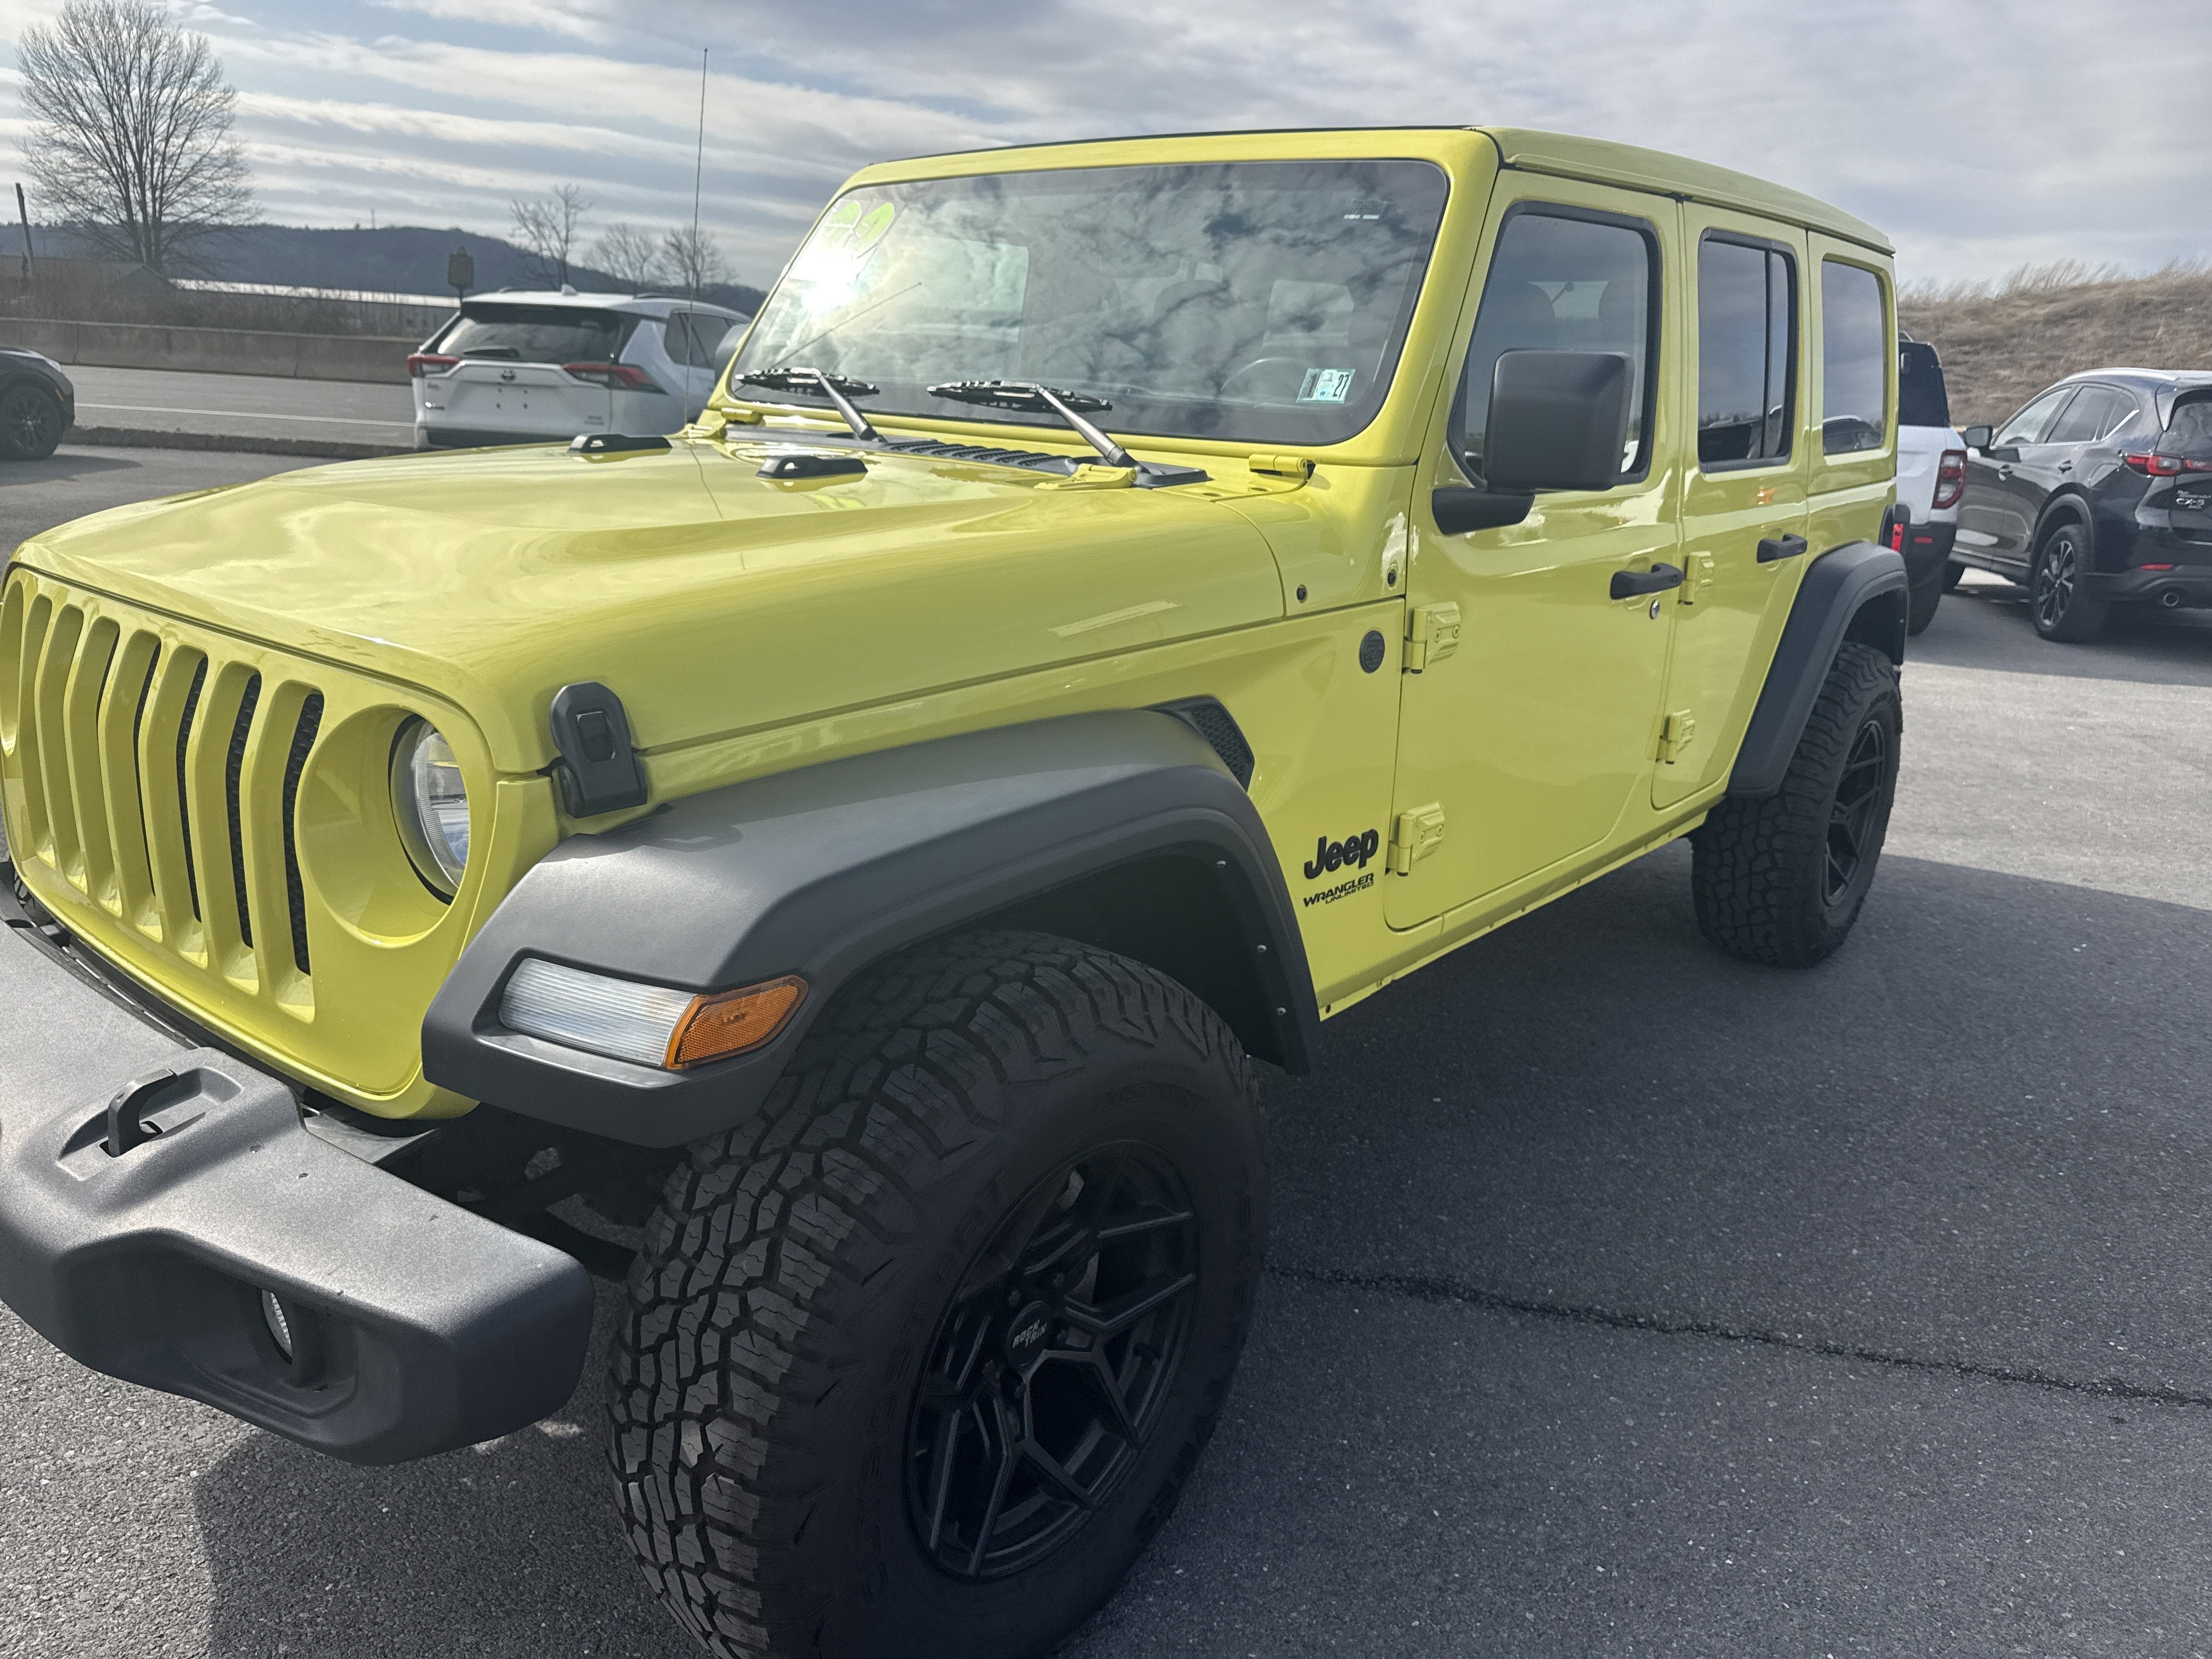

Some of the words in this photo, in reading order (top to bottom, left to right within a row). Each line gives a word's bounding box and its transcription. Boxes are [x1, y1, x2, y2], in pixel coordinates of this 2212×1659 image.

[1307, 373, 1317, 397] 1
[1332, 374, 1350, 399] 27
[1304, 828, 1379, 879] Jeep
[1303, 872, 1374, 907] WRANGLER
[1325, 881, 1374, 904] UNLIMITED
[1012, 1319, 1041, 1348] ROCK
